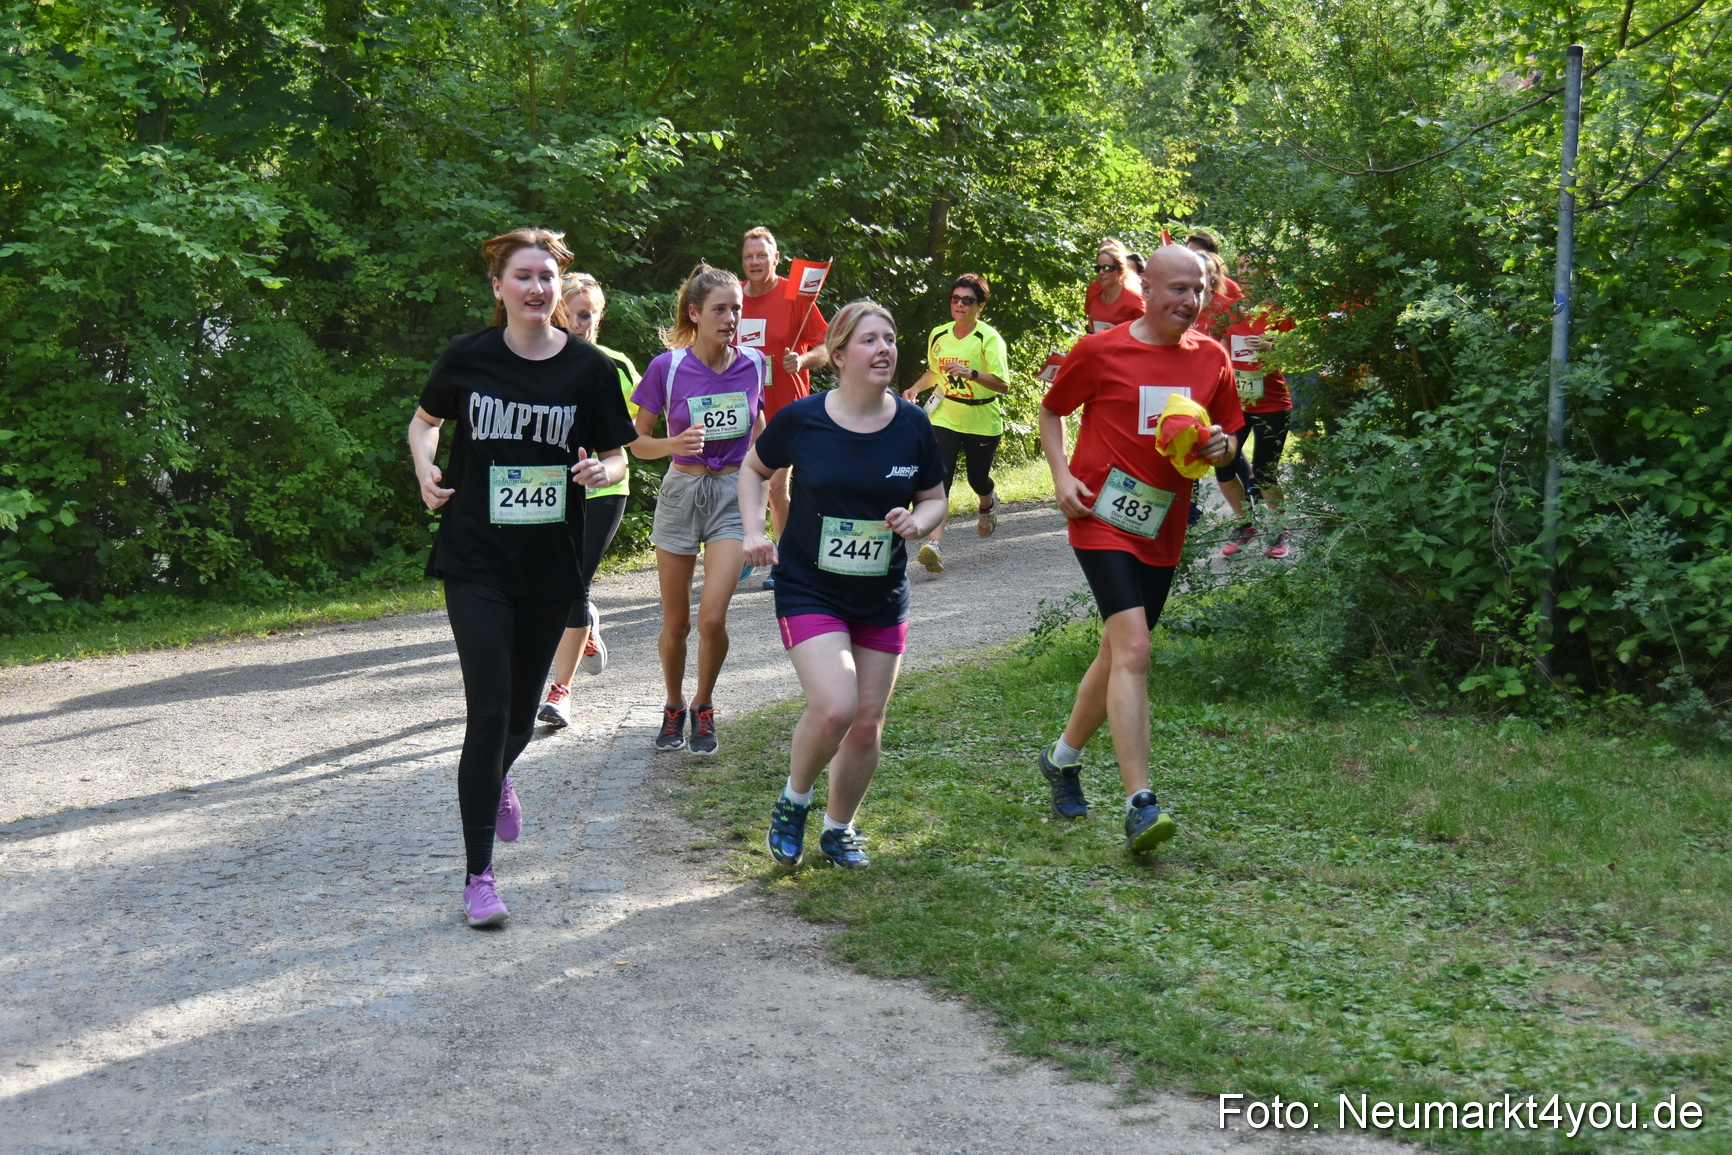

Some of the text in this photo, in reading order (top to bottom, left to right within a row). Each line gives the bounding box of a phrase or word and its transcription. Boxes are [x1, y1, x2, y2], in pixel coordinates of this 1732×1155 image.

[469, 391, 577, 453] COMPTON
[704, 409, 737, 428] 625
[500, 487, 557, 508] 2448
[1112, 495, 1152, 521] 483
[828, 538, 884, 560] 2447
